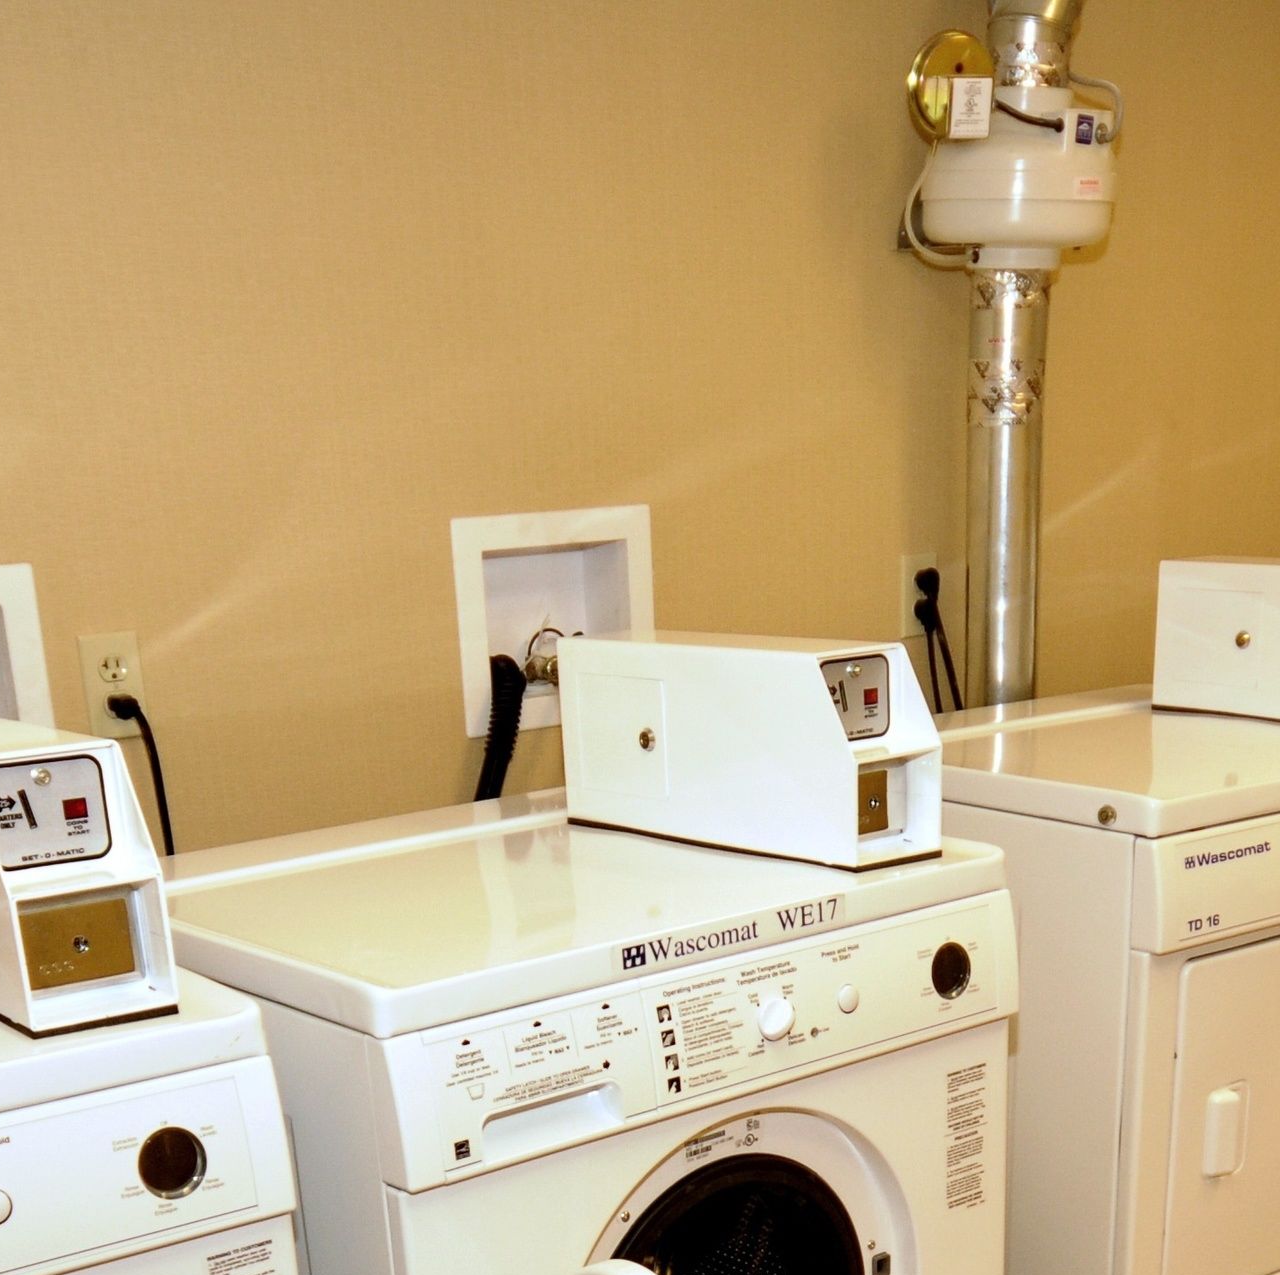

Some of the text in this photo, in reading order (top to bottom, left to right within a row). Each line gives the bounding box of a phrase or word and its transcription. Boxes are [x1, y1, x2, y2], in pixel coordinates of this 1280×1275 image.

[1196, 841, 1271, 867] Wascomat
[647, 898, 838, 962] Wascomat WE17
[1188, 914, 1220, 932] TD 16
[662, 986, 691, 998] Operating
